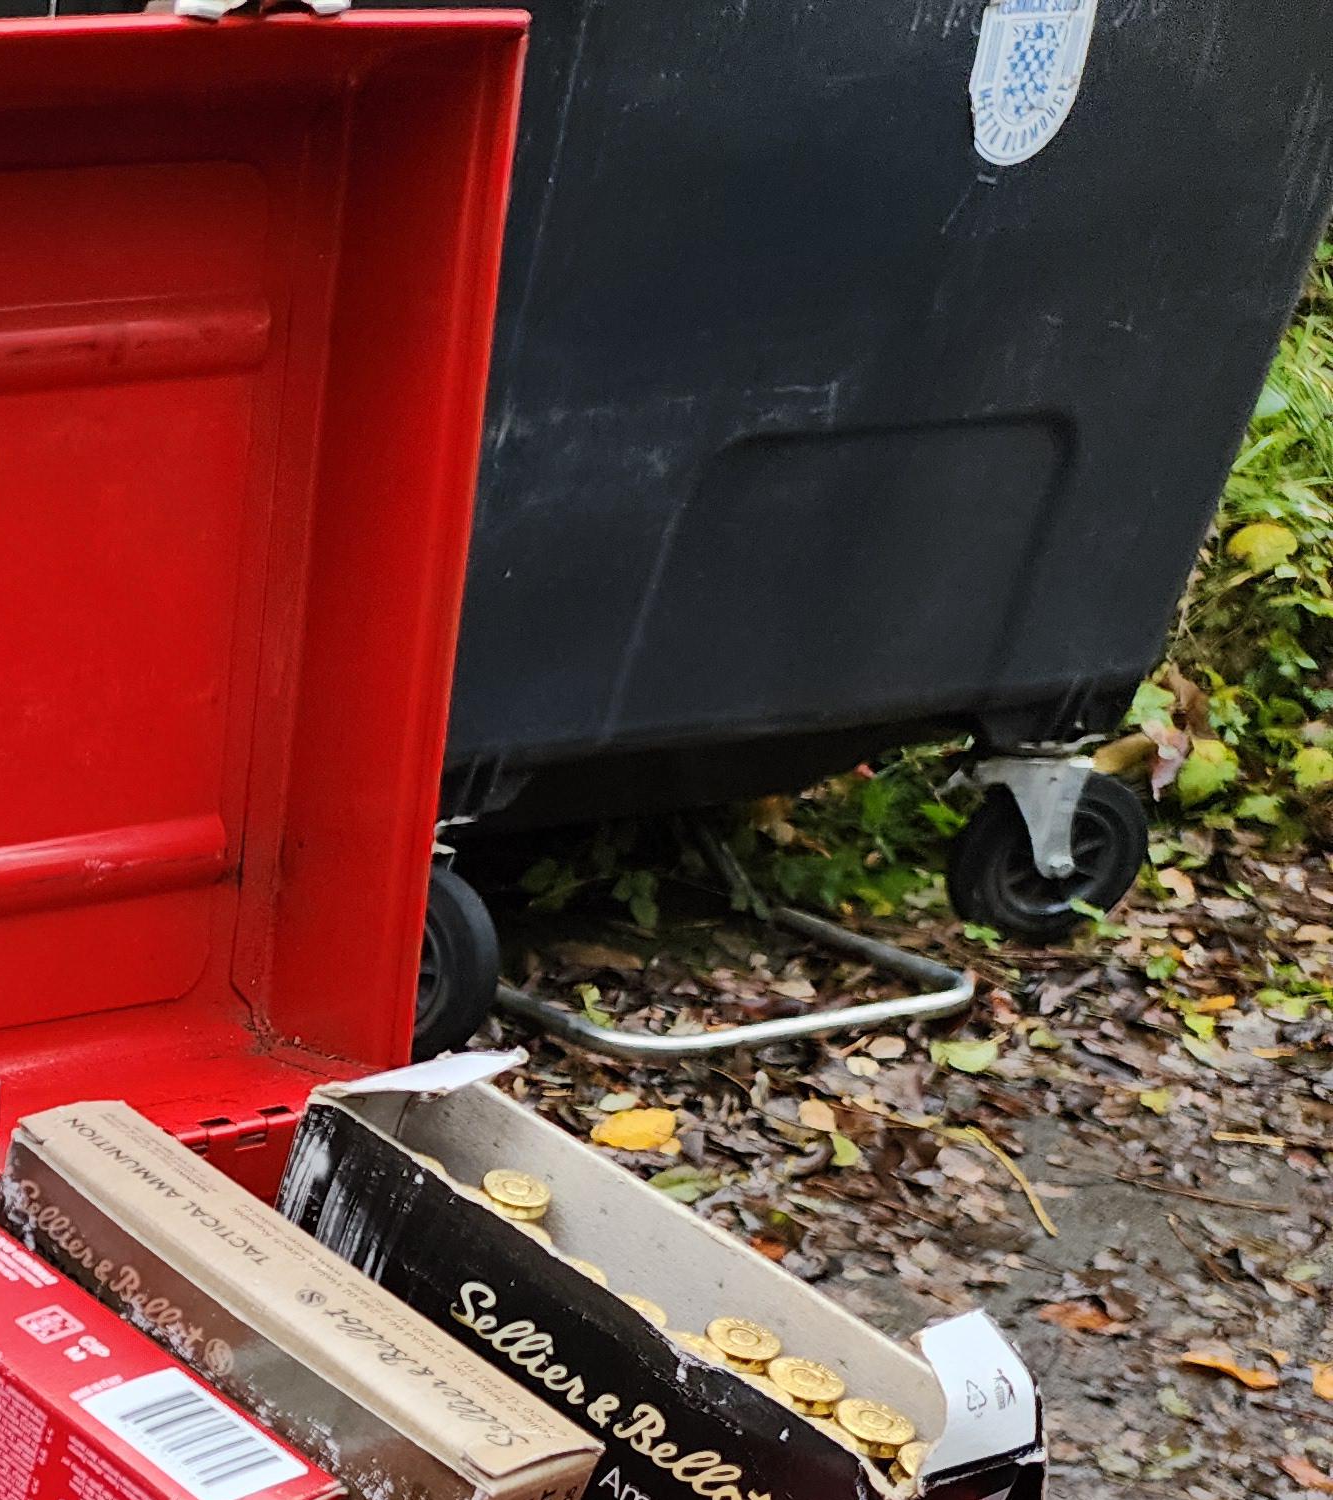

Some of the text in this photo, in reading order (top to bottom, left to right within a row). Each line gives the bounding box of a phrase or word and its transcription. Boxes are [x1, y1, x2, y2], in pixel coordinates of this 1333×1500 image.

[62, 1117, 185, 1201] AMMUNITION
[181, 1199, 270, 1266] TACTICAL
[91, 1257, 115, 1282] &
[322, 1309, 419, 1368] Bellot
[452, 1282, 584, 1405] Sellier
[587, 1393, 615, 1423] &
[432, 1379, 524, 1450] Sellier
